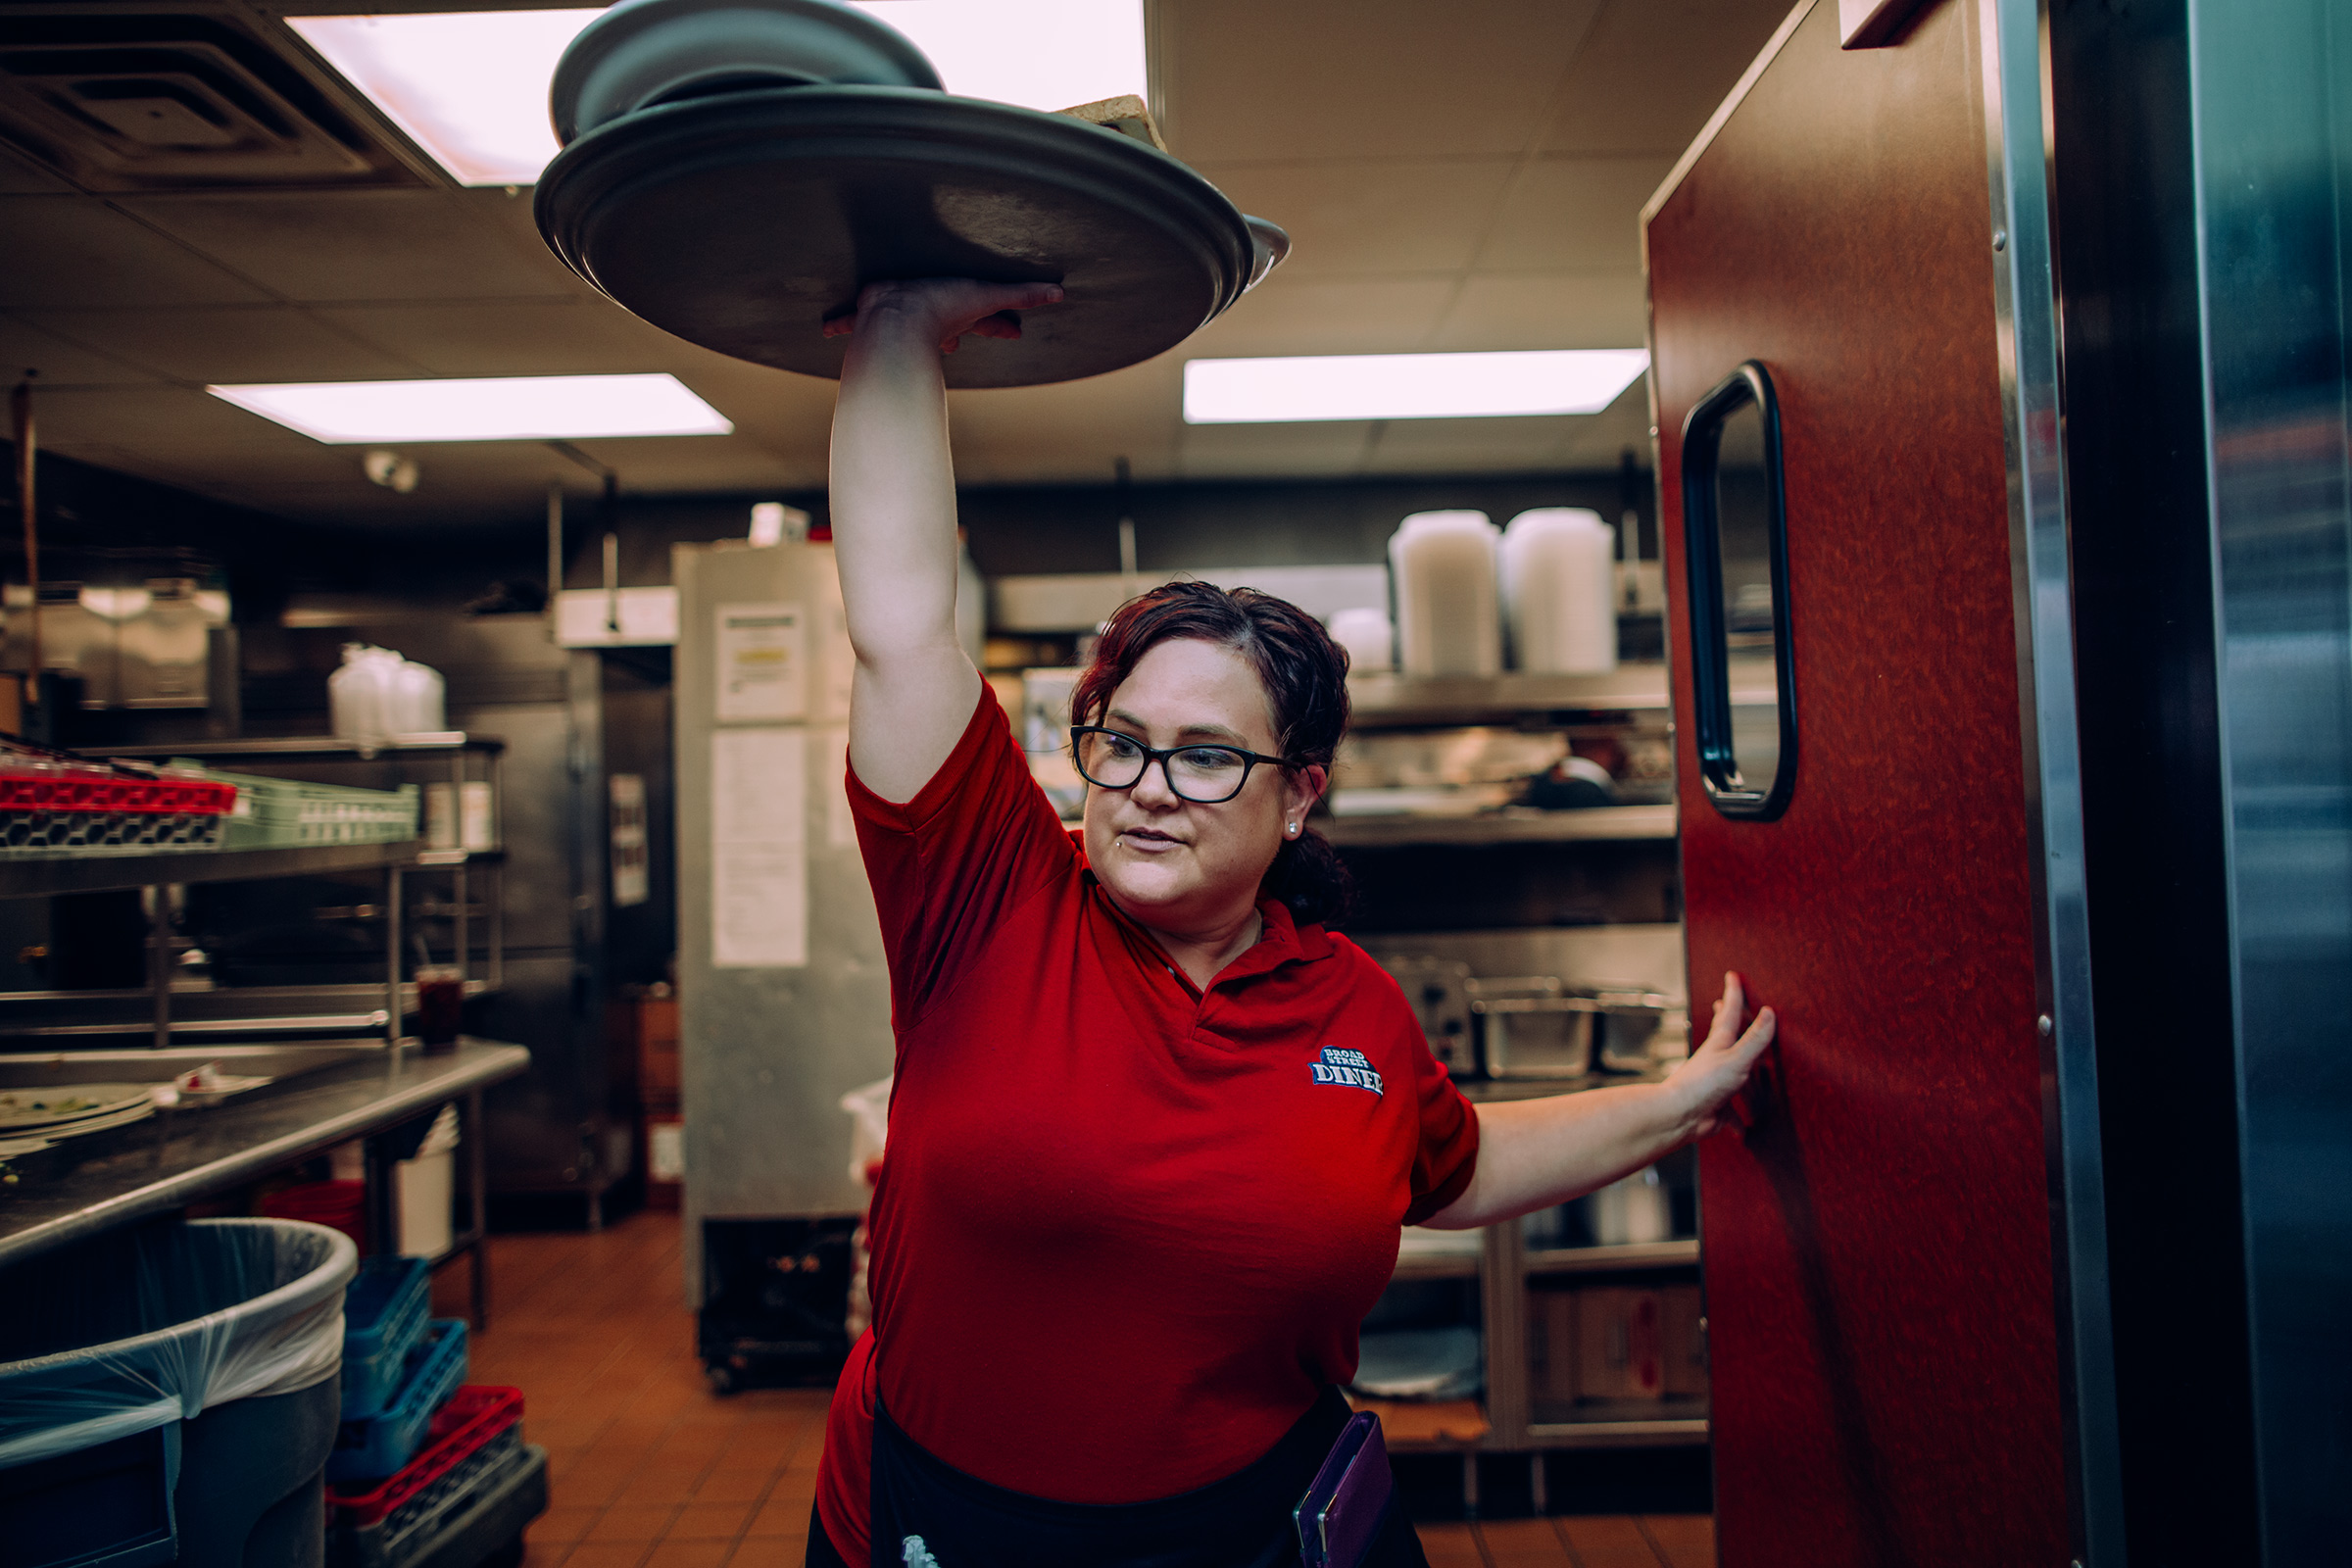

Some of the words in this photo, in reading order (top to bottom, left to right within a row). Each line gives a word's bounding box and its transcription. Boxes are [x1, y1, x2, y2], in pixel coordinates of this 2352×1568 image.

[1324, 1049, 1365, 1060] BROAD
[1327, 1056, 1369, 1068] STREET
[1313, 1063, 1383, 1096] DINER
